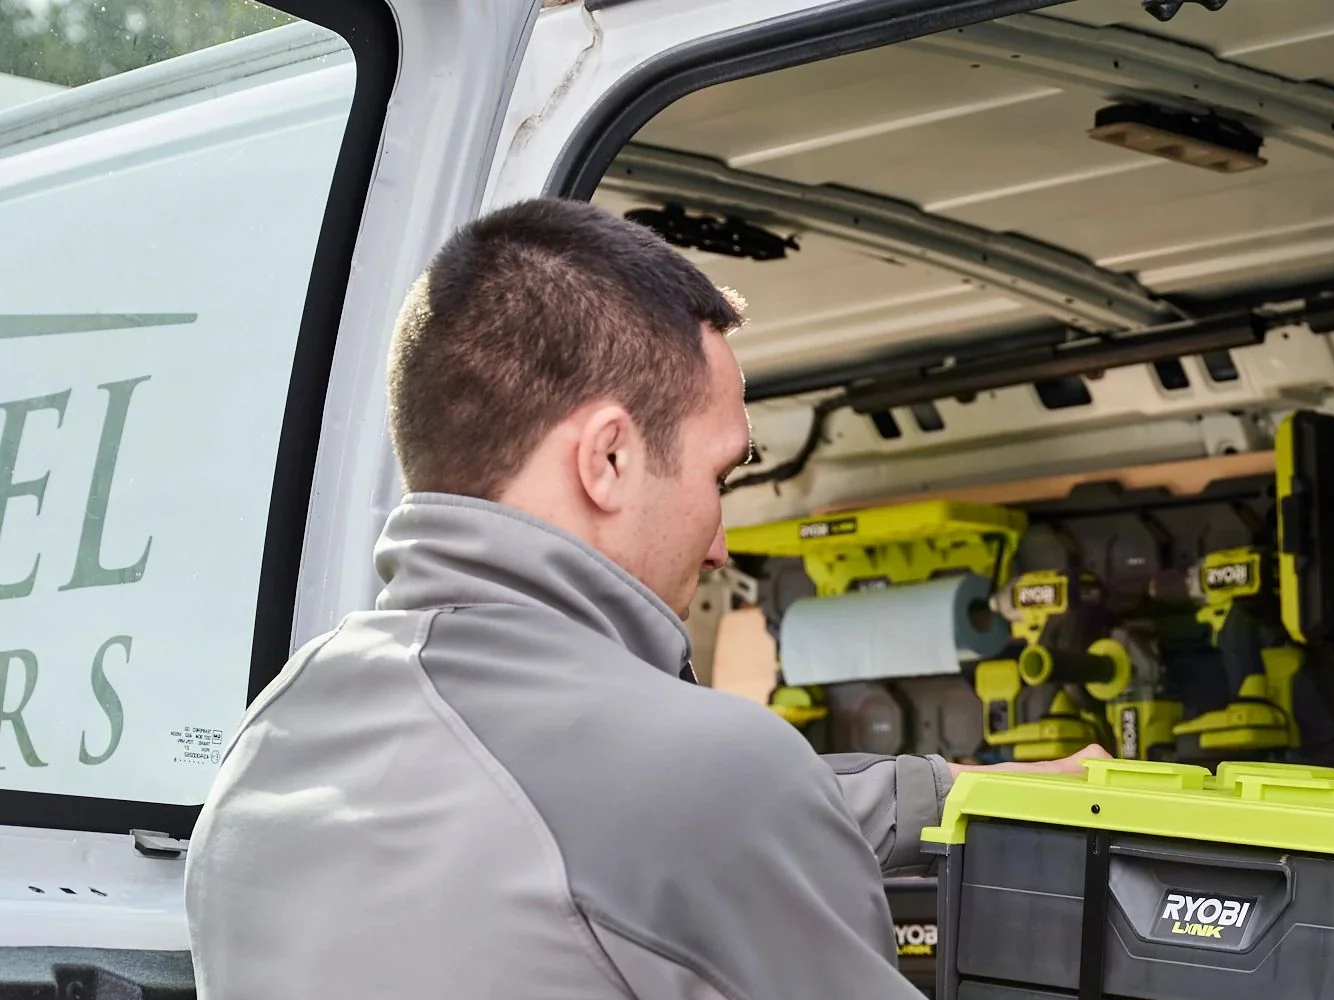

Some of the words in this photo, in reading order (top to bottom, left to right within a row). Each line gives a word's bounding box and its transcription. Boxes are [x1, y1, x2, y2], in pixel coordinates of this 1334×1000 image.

[1207, 566, 1248, 585] RYOBI
[1019, 586, 1055, 604] RYOBI
[1162, 894, 1250, 928] RYOBI
